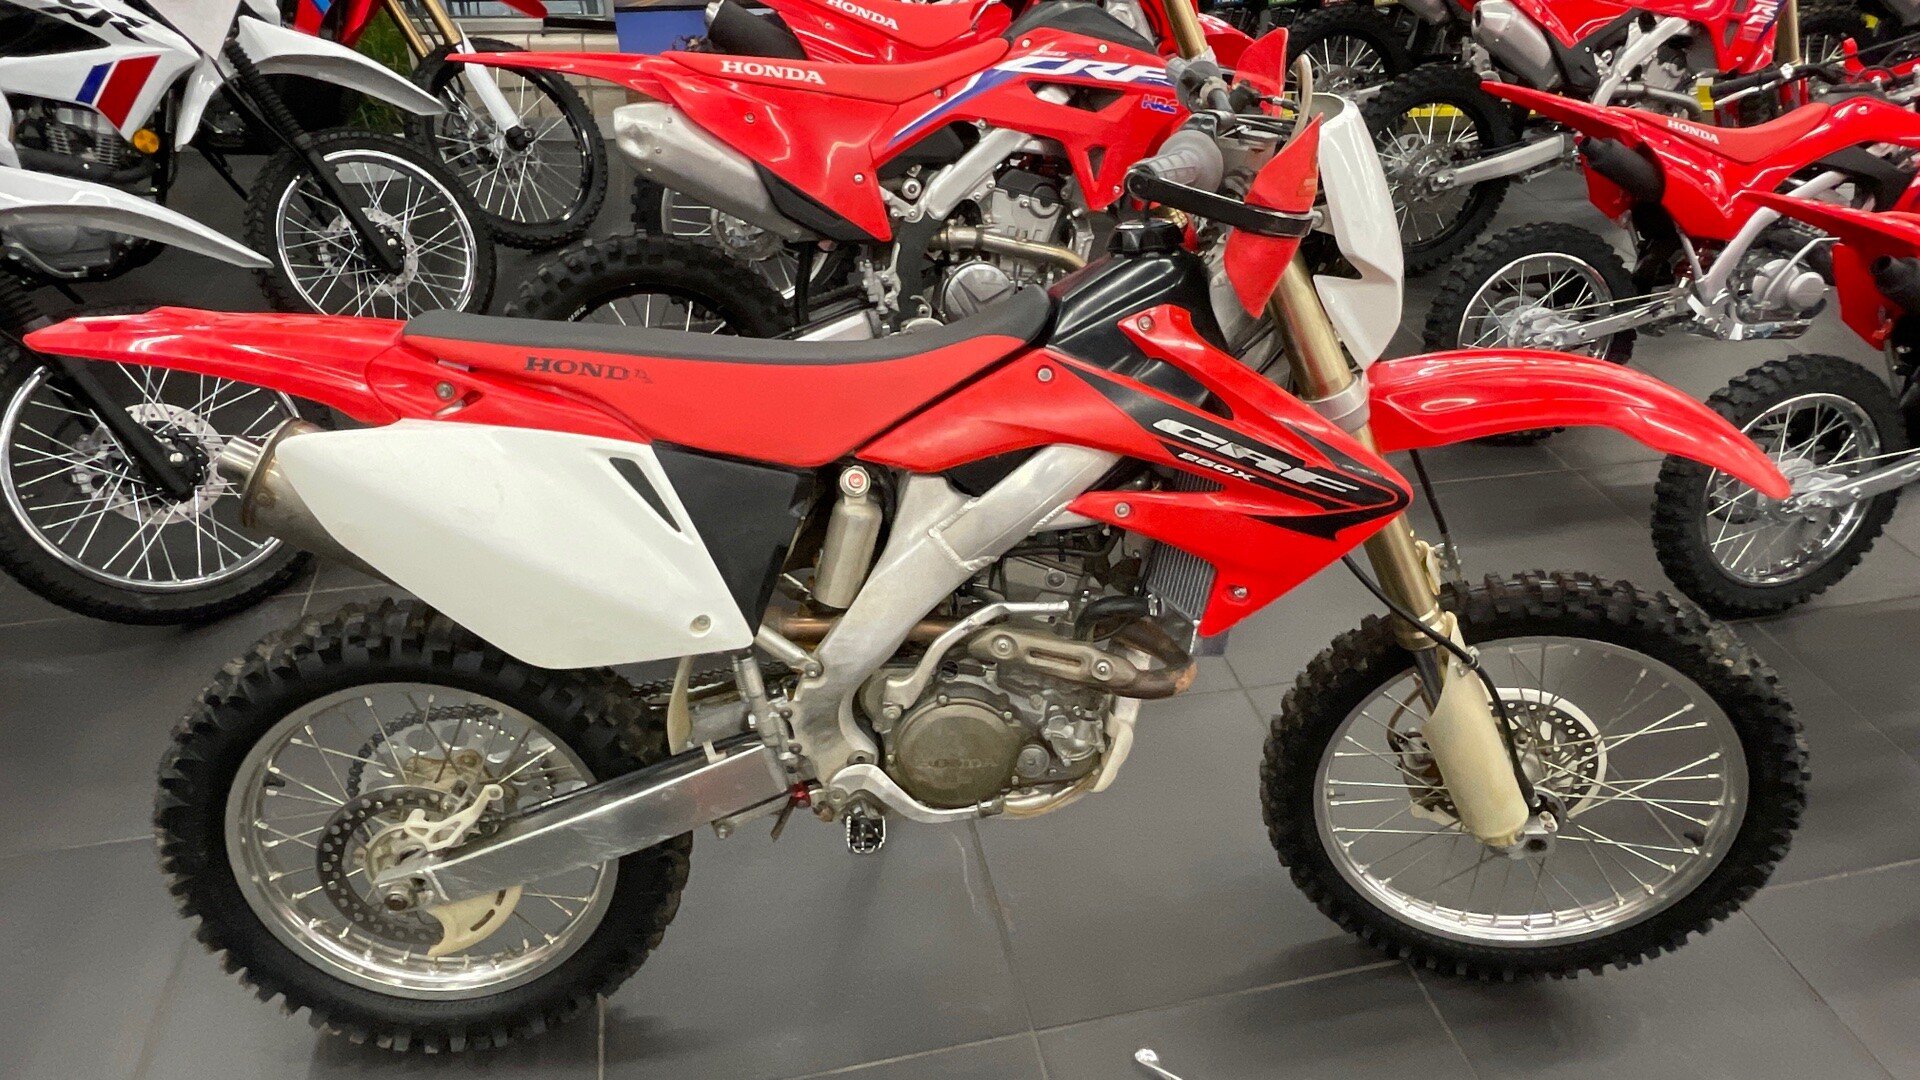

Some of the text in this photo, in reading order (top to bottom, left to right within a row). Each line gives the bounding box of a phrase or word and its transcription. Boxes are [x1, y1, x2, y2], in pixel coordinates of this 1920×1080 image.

[826, 0, 899, 31] HONDA
[720, 60, 826, 85] HONDA
[993, 55, 1168, 83] CRF
[1141, 94, 1179, 114] HRC
[1667, 119, 1719, 145] HONDA
[1153, 418, 1360, 493] CRF
[1178, 452, 1257, 482] 250X
